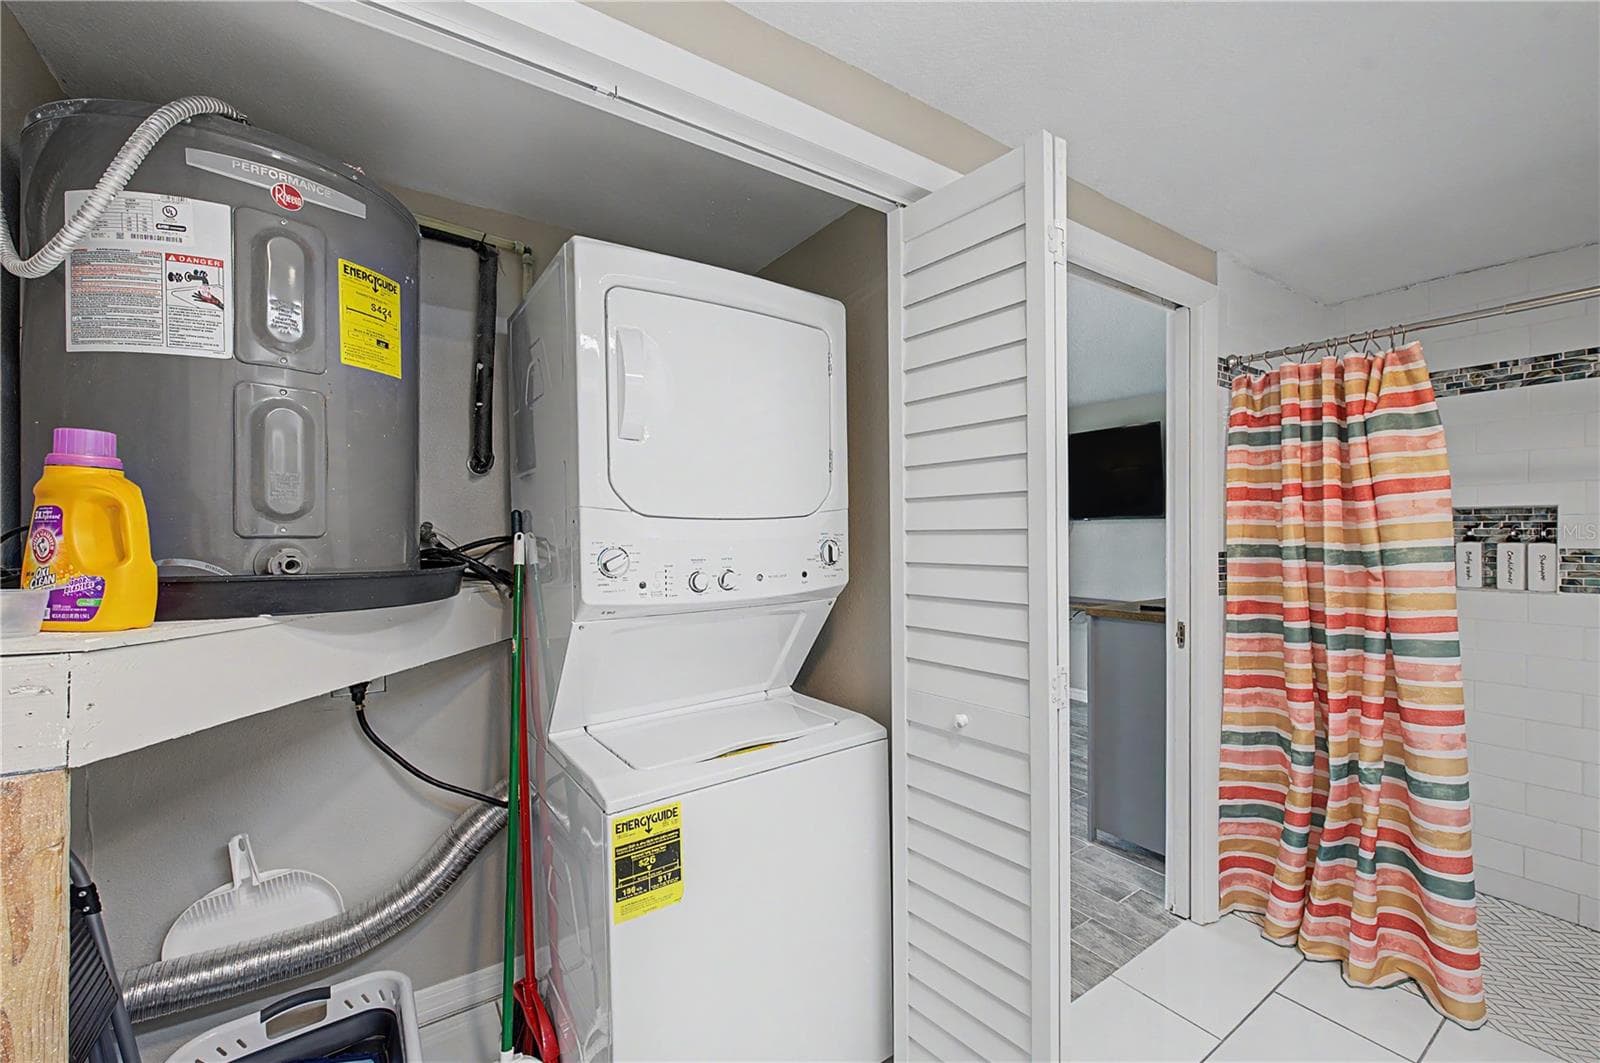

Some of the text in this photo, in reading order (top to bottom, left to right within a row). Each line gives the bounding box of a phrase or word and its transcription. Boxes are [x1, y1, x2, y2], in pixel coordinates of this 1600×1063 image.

[232, 160, 332, 198] PERFORMANCE
[275, 184, 302, 206] Rheem
[179, 255, 221, 267] DANGER
[343, 264, 398, 295] ENERGYGUIDE
[30, 573, 56, 589] CLEAN
[36, 567, 50, 579] OXI
[615, 807, 678, 834] ENERGYGUIDE
